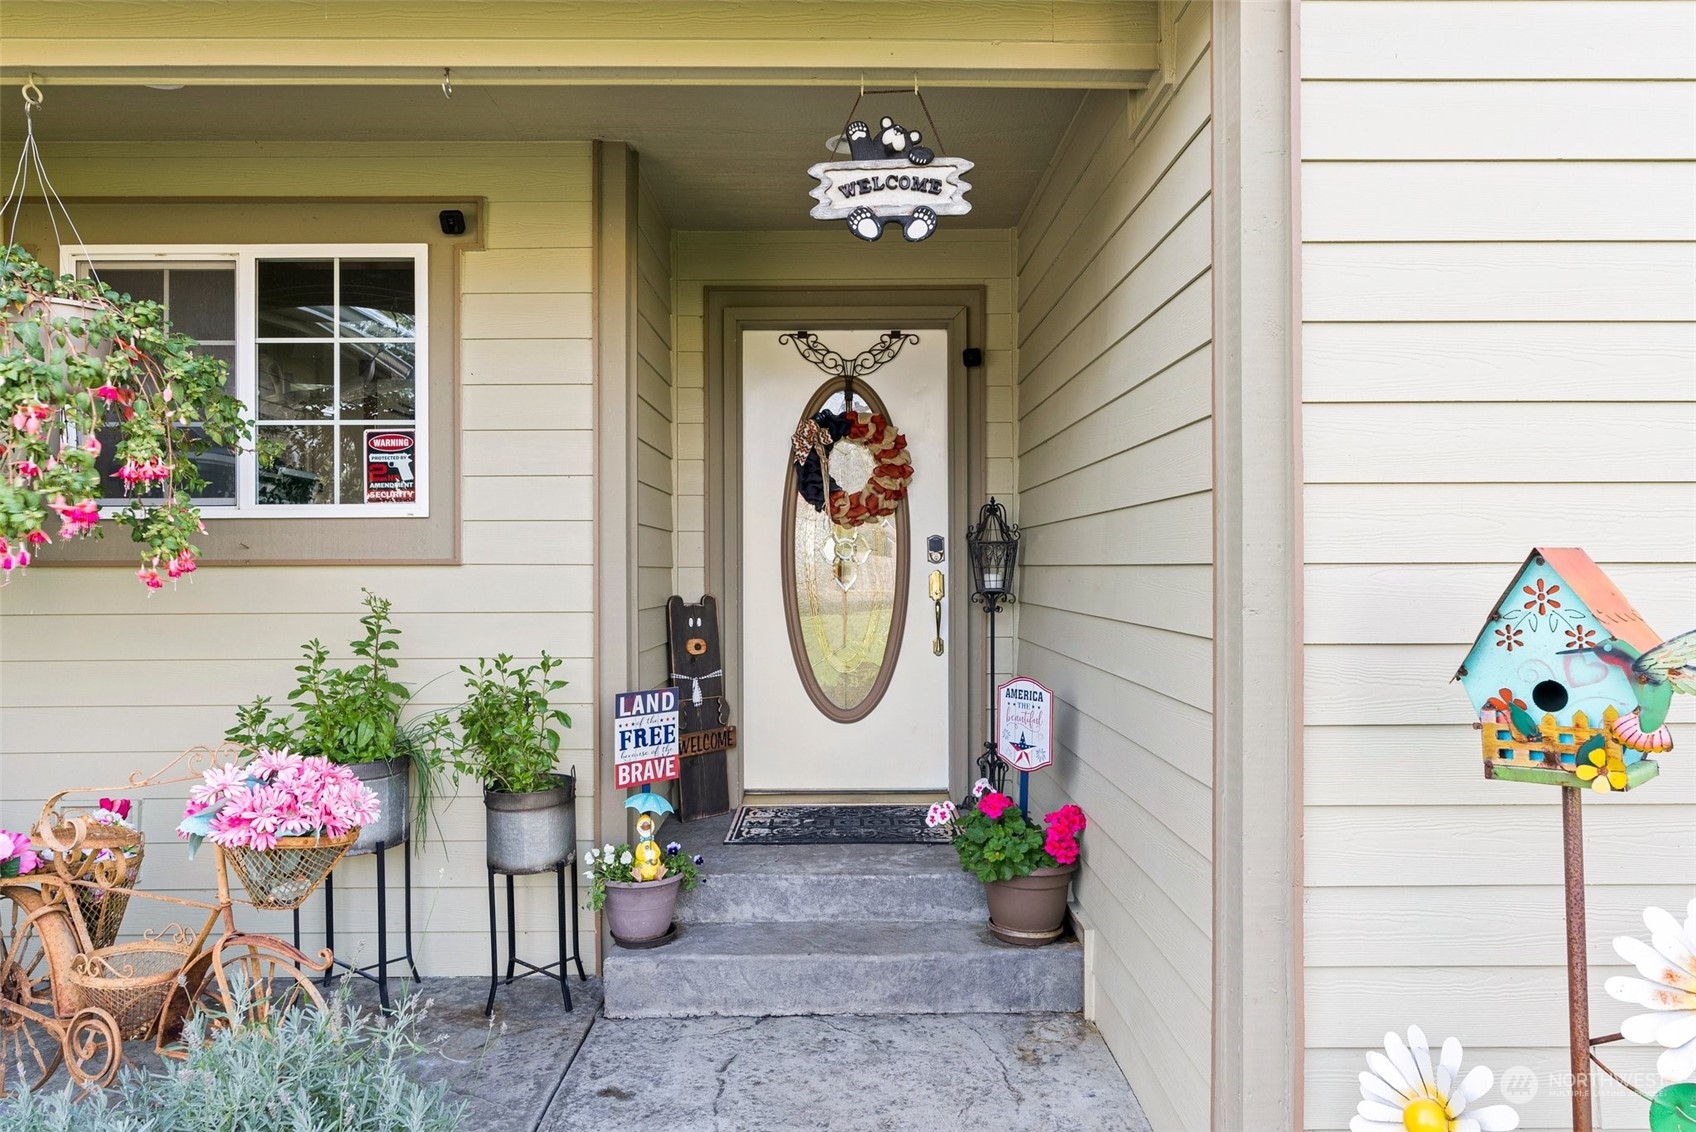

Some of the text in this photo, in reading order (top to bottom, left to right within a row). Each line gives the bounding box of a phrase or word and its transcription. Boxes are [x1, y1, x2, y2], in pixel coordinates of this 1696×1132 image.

[838, 175, 943, 198] WELCOME
[373, 439, 409, 447] WARNING
[620, 691, 675, 717] LAND
[1005, 688, 1044, 702] AMERICA
[636, 715, 658, 727] of the
[1006, 706, 1043, 729] beautiful
[619, 723, 676, 751] FREE
[679, 730, 733, 755] WELCOME
[621, 744, 673, 761] because of the
[618, 756, 676, 786] BRAVE
